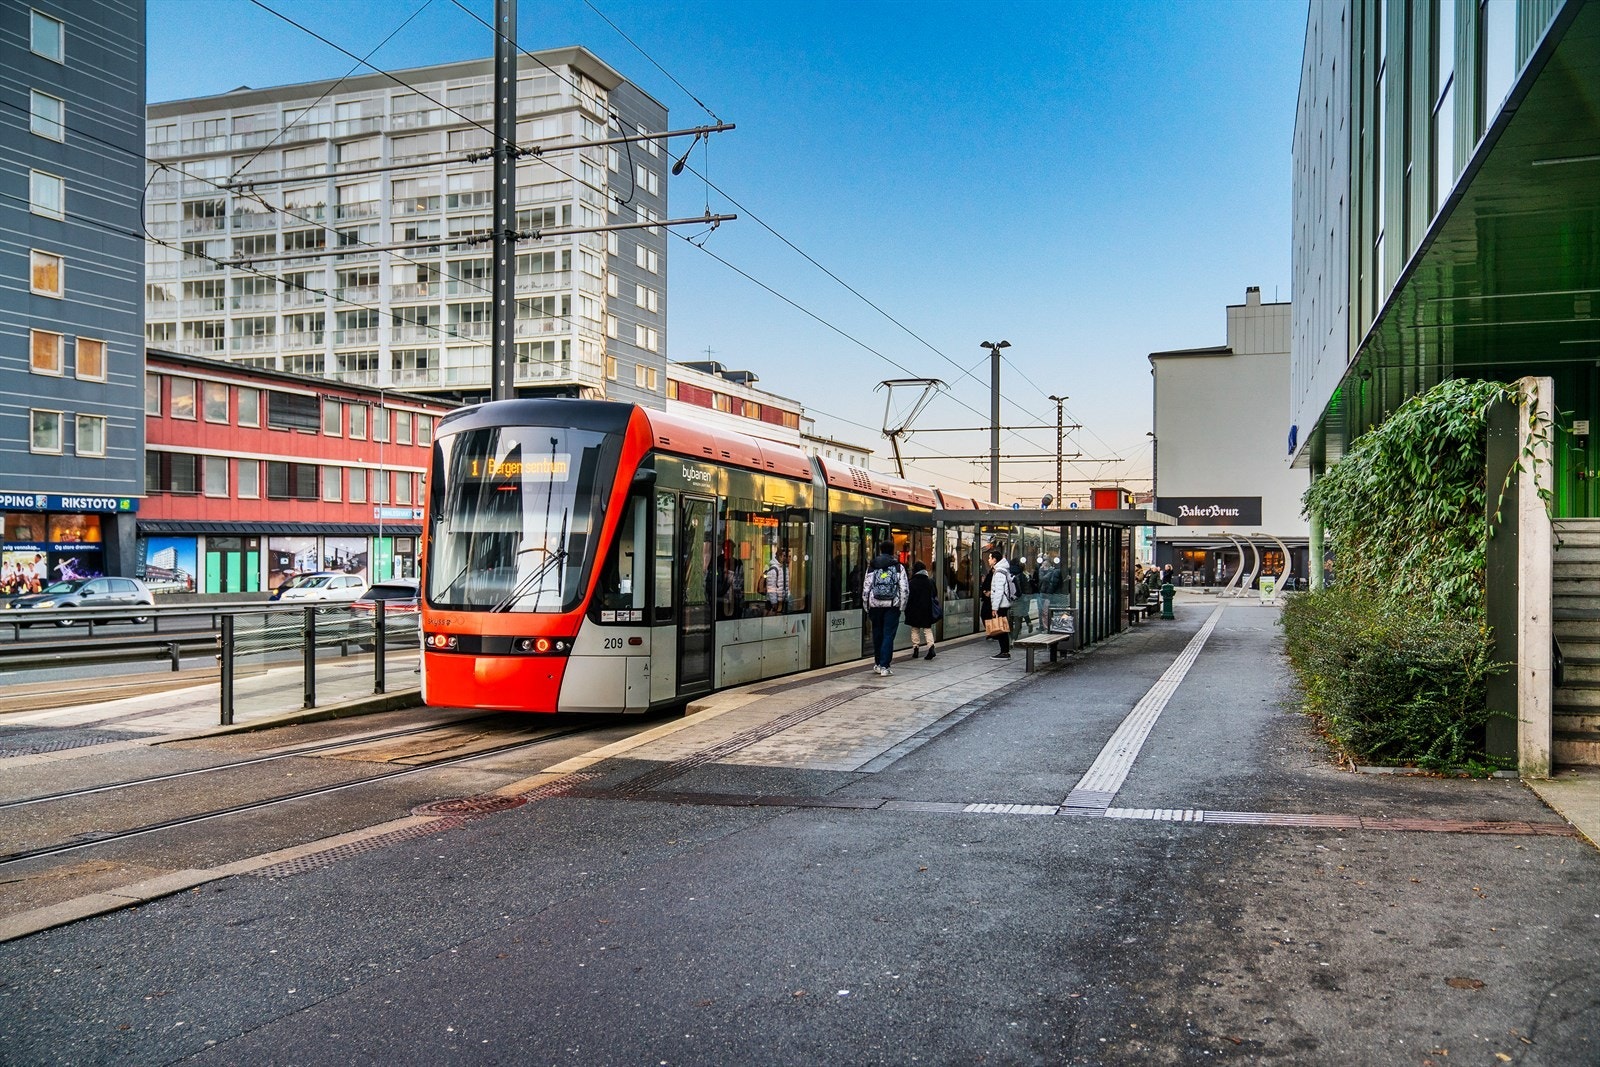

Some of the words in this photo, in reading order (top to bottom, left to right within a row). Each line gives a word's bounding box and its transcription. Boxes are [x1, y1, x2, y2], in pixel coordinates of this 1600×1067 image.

[471, 459, 478, 476] 1
[488, 458, 522, 478] Bergen
[525, 457, 566, 473] sentrum
[682, 464, 711, 481] bybanen
[61, 497, 117, 509] RIKSTOTO
[1178, 504, 1240, 518] BakerBrun
[428, 617, 446, 627] skyss
[604, 637, 623, 649] 209
[643, 663, 649, 671] A
